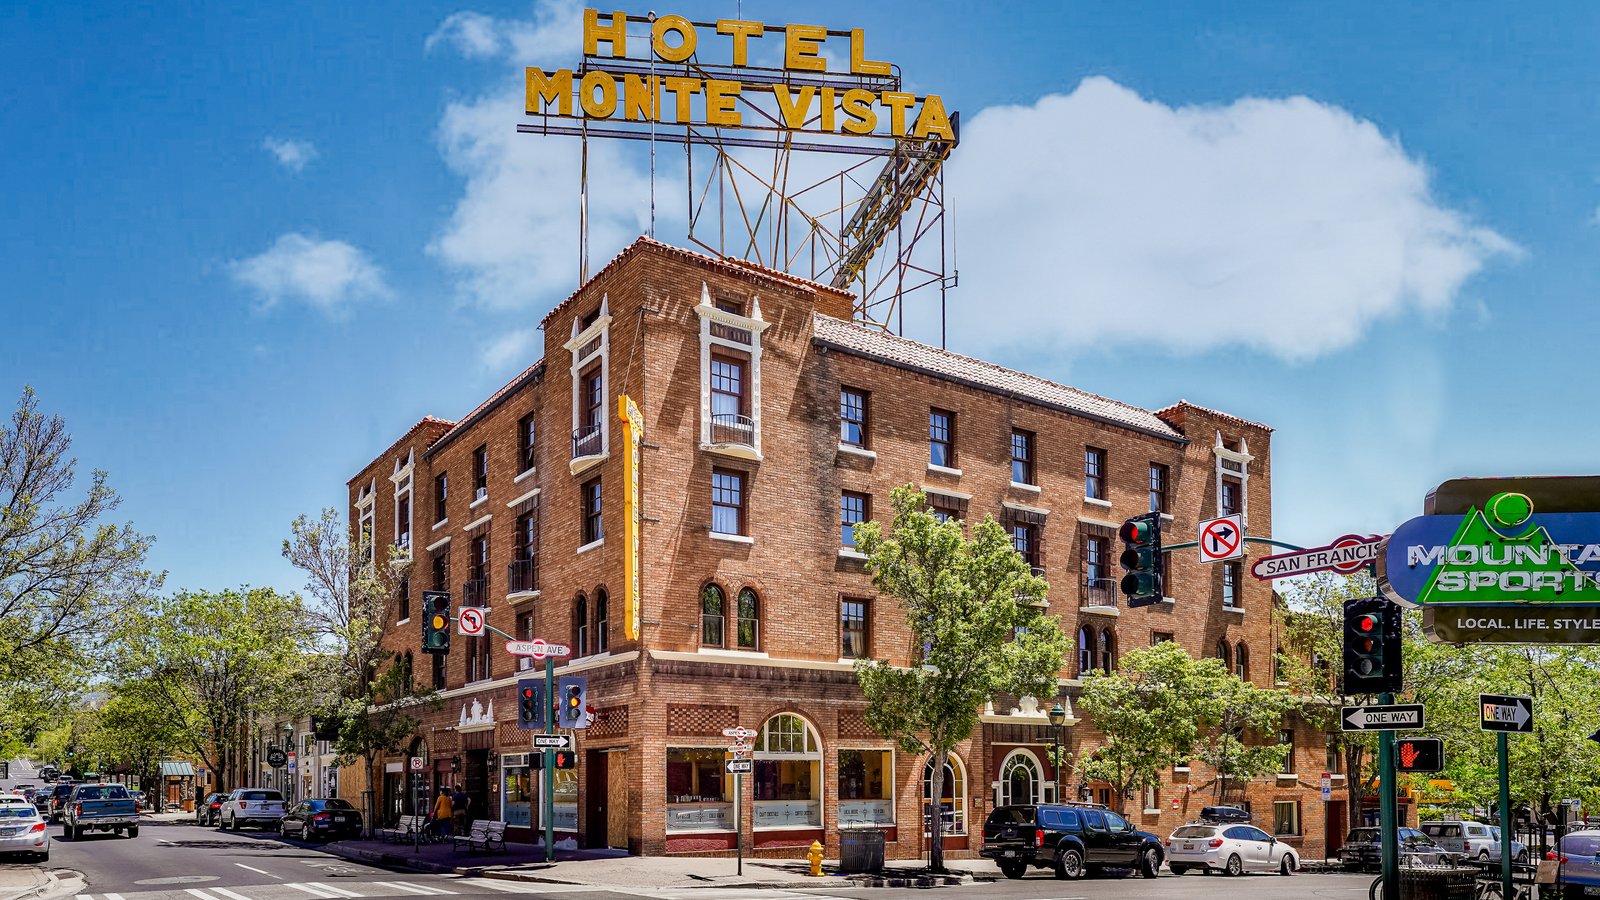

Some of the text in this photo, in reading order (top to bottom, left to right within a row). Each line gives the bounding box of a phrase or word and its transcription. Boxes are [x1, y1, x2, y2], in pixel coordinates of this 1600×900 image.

[583, 8, 892, 76] HOTEL
[525, 66, 955, 140] MONTE VISTA
[1266, 556, 1300, 574] SAN
[1437, 570, 1600, 592] SPORT
[1457, 618, 1511, 629] LOCAL.
[1514, 618, 1550, 630] LIFE.
[515, 643, 563, 654] ASPEN AVE
[1365, 712, 1414, 723] ONE WAY
[1485, 705, 1517, 721] ONE WAY
